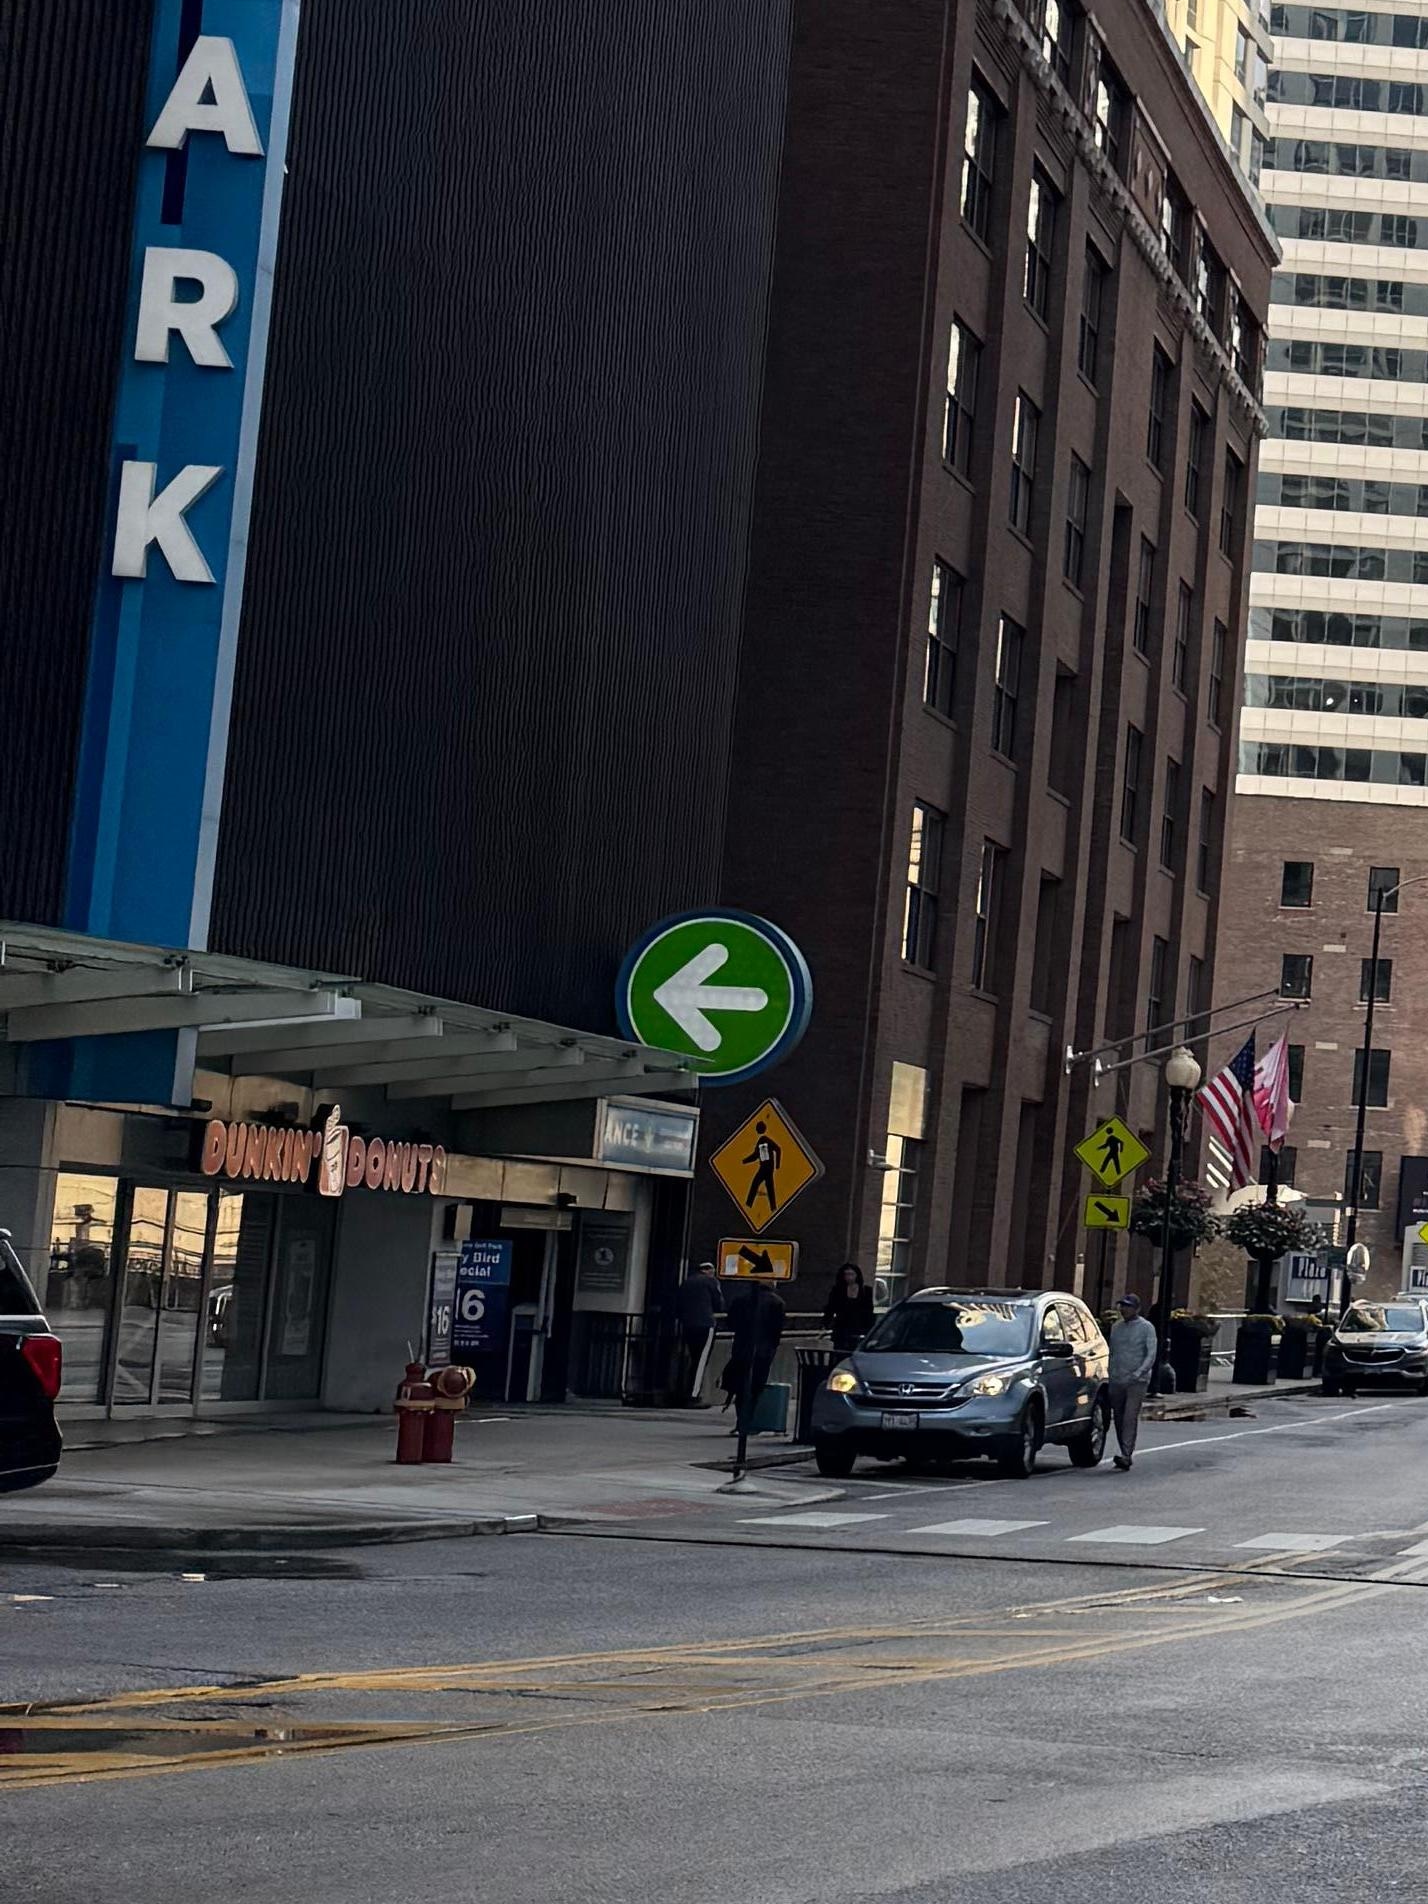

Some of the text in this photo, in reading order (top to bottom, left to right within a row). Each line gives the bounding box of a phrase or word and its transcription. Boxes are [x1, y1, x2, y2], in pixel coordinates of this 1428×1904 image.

[202, 1119, 447, 1195] DUNKIN' DONUTS
[459, 1265, 491, 1277] ecial
